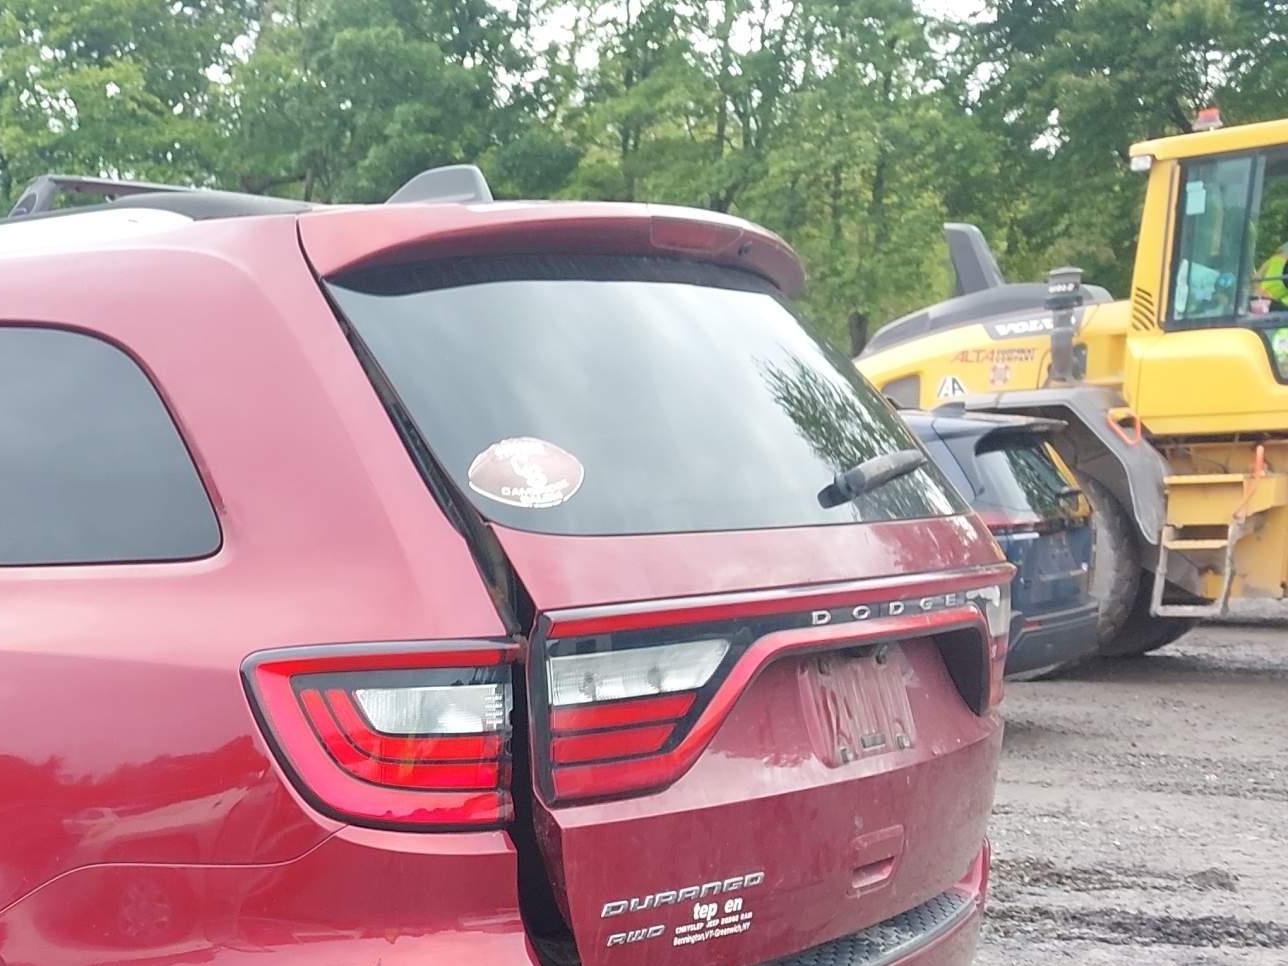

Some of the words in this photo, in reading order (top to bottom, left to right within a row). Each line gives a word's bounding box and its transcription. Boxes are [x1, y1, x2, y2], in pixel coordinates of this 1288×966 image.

[812, 593, 957, 625] DODGE
[601, 872, 764, 917] DURANGO
[607, 925, 665, 946] AWD
